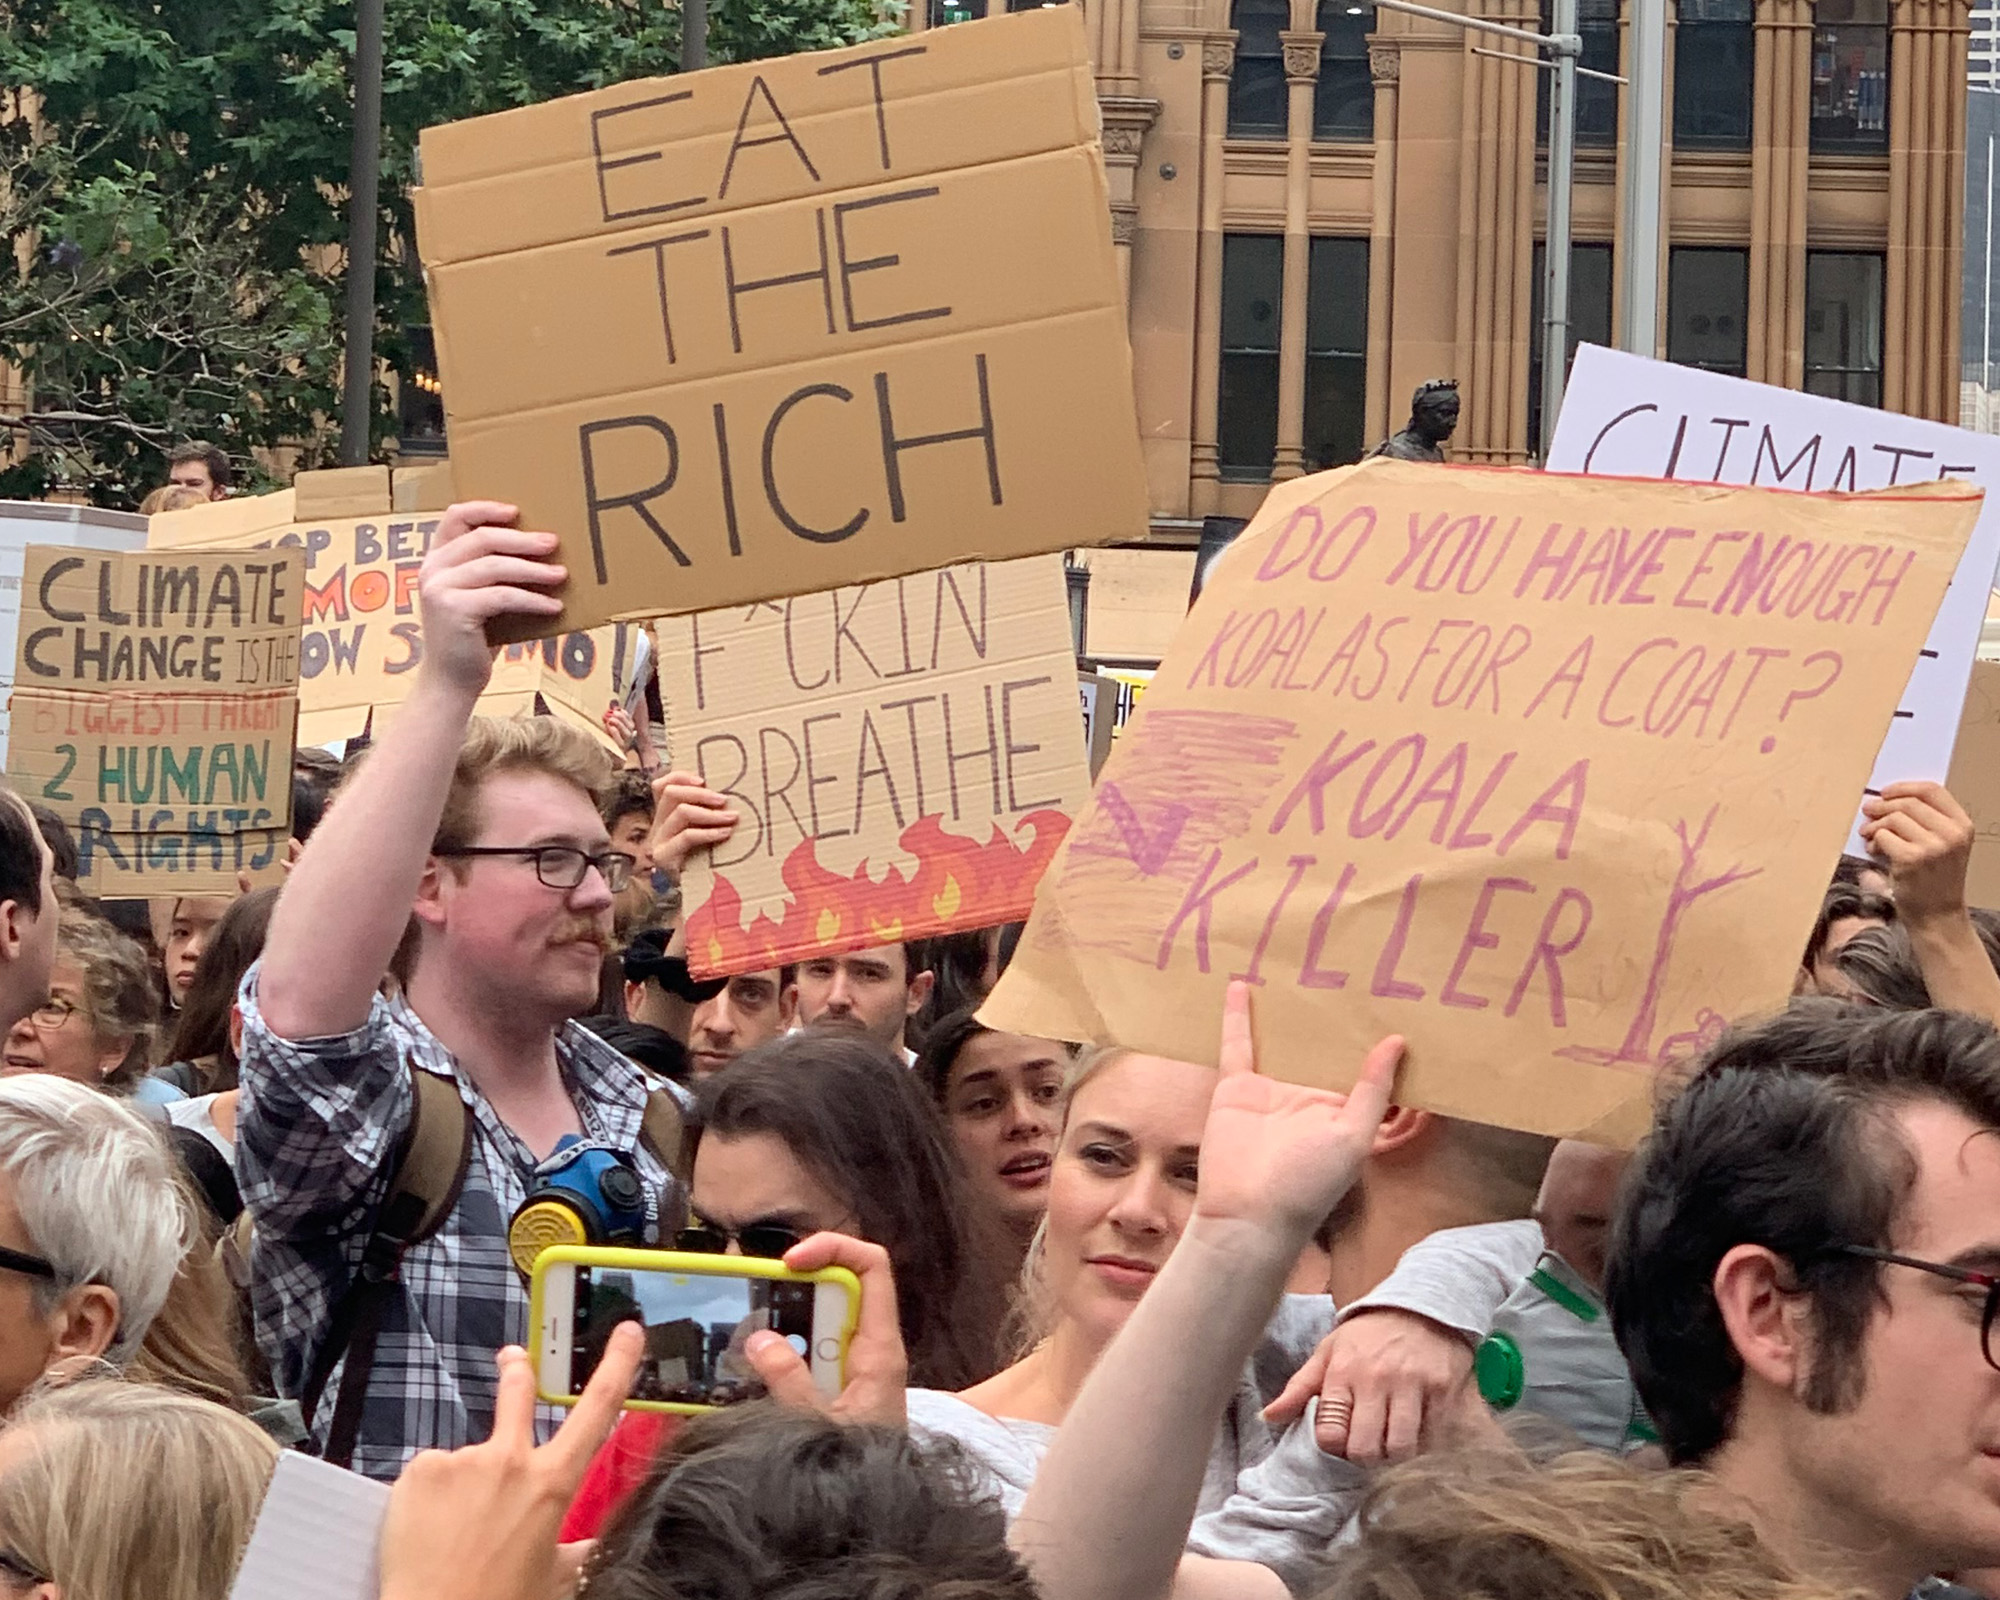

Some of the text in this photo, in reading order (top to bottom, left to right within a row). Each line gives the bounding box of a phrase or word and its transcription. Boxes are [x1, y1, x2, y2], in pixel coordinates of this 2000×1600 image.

[590, 46, 927, 223] EAT
[606, 186, 952, 364] THE
[579, 353, 1004, 586] RICH
[39, 556, 289, 629] CLIMATE
[1255, 504, 1917, 626] DO YOU HAVE ENOUGH
[23, 626, 295, 684] CHANGE IS THE
[33, 689, 184, 736] BIGGEST
[1187, 605, 1844, 755] KOALAS FOR A COAT?
[42, 738, 271, 806] 2 HUMAN
[697, 675, 1063, 869] BREATHE
[1268, 729, 1591, 861] KOALA
[77, 806, 276, 878] RIGHTS
[1156, 846, 1594, 1028] KILLER
